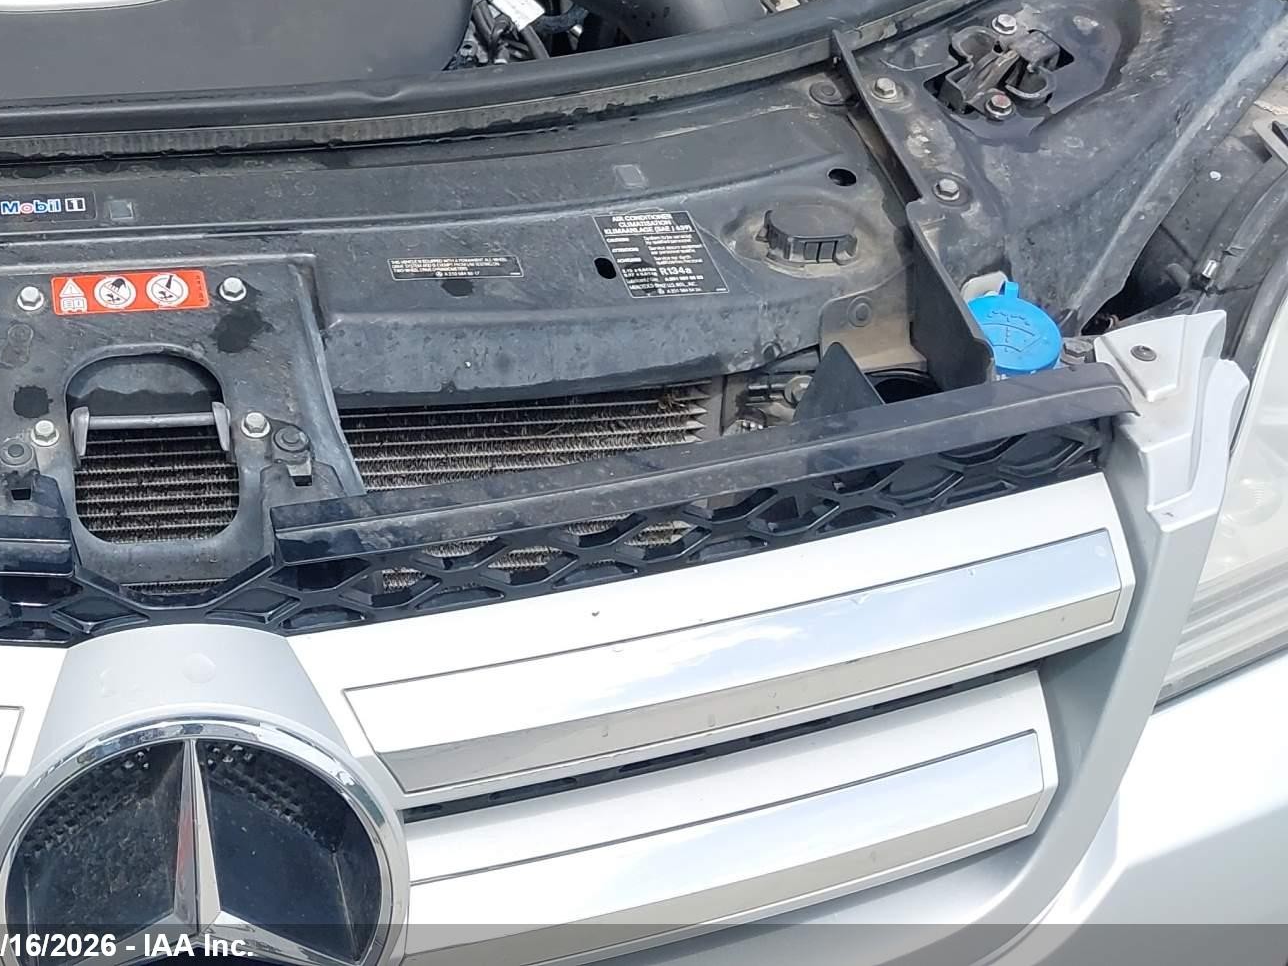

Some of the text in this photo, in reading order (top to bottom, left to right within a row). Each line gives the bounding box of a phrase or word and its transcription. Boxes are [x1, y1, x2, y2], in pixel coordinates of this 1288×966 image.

[0, 198, 62, 215] Mobil
[624, 213, 672, 221] CONDITIONER
[659, 266, 692, 275] R134a
